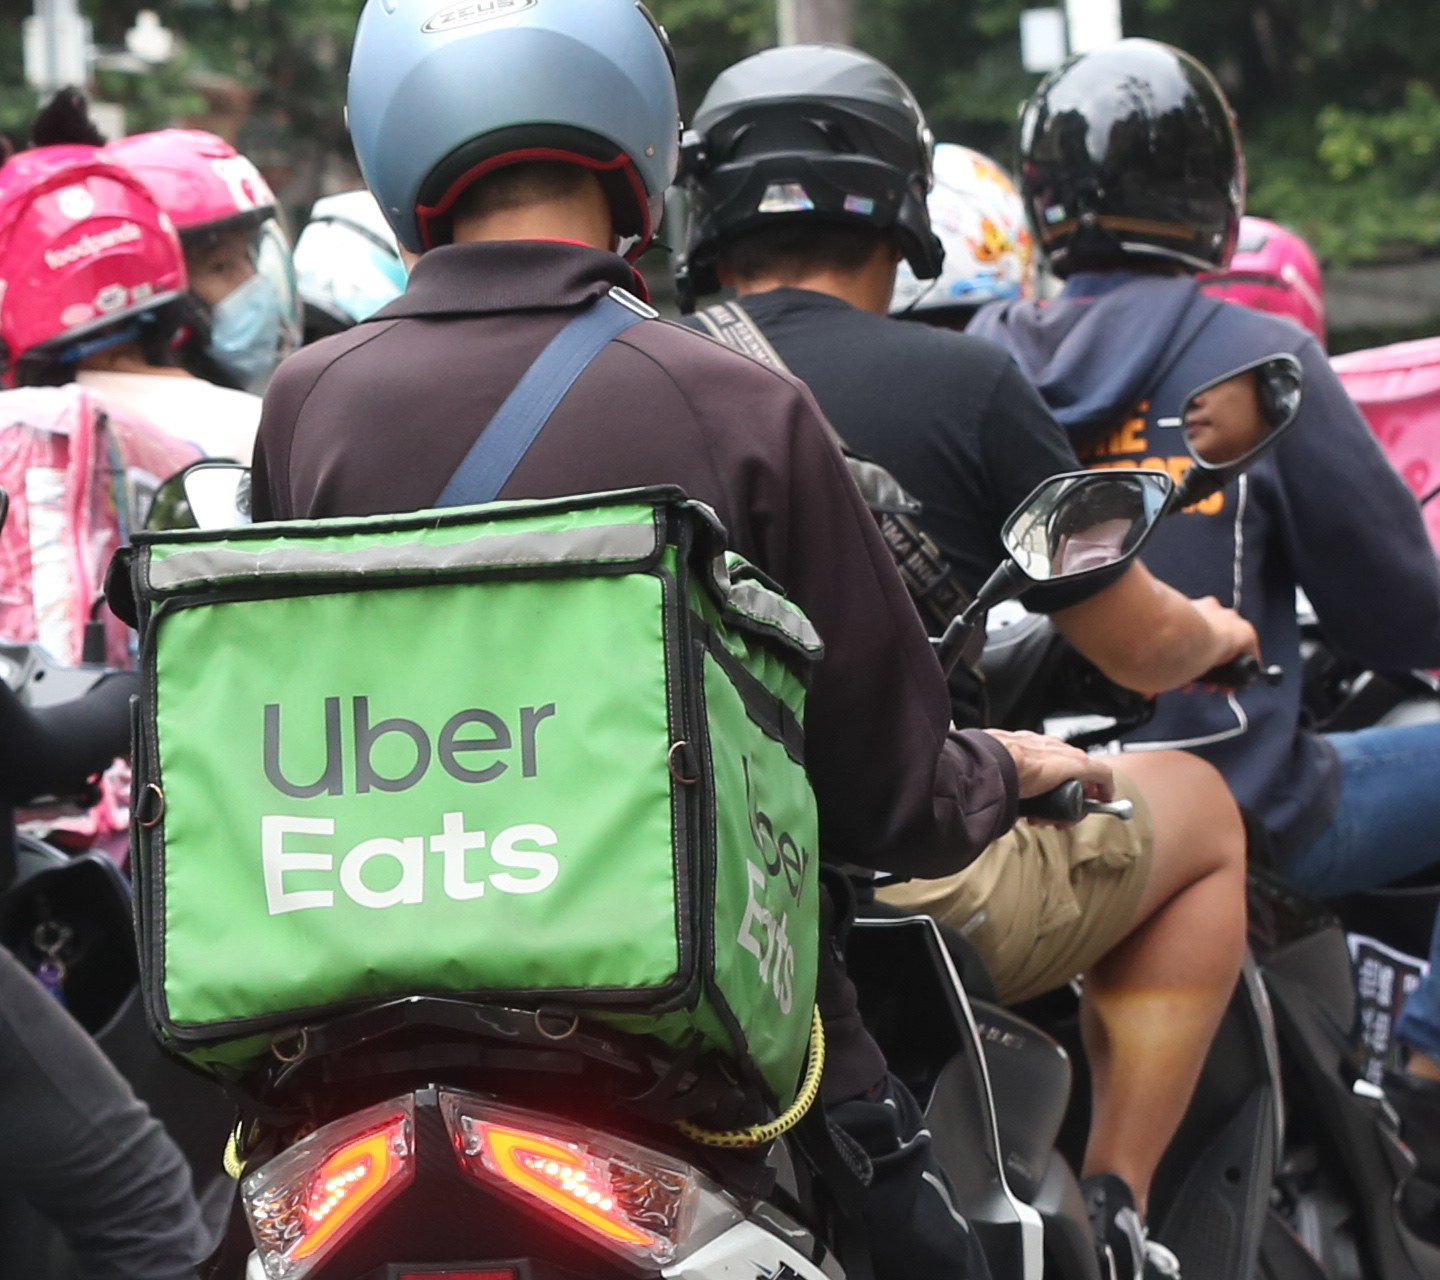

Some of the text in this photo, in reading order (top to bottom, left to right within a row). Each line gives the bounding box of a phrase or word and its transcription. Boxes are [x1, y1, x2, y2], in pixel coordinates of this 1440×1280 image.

[44, 220, 142, 270] foodpanda
[262, 695, 557, 802] Uber
[262, 810, 560, 916] Eats
[742, 754, 810, 908] Uber
[737, 858, 795, 1016] Eats
